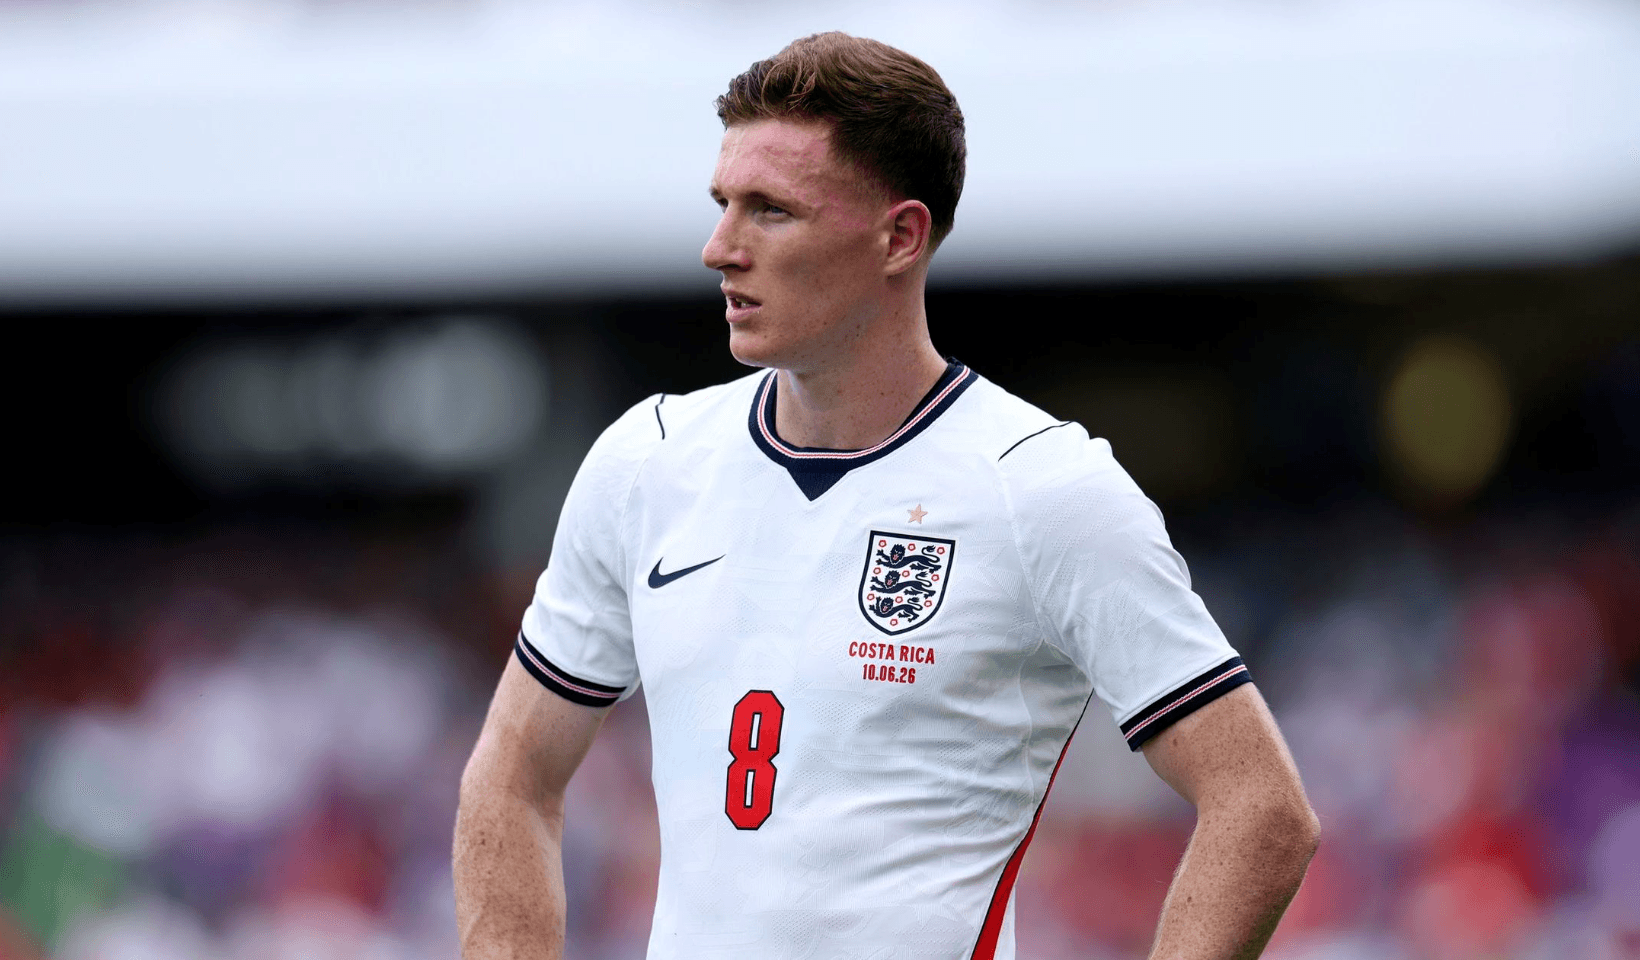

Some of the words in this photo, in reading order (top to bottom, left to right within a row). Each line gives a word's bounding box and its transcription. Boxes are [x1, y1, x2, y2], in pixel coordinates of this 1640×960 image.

[848, 641, 895, 660] COSTA
[899, 645, 935, 664] RICA
[862, 663, 916, 684] 10.06.26
[725, 689, 785, 830] 8
